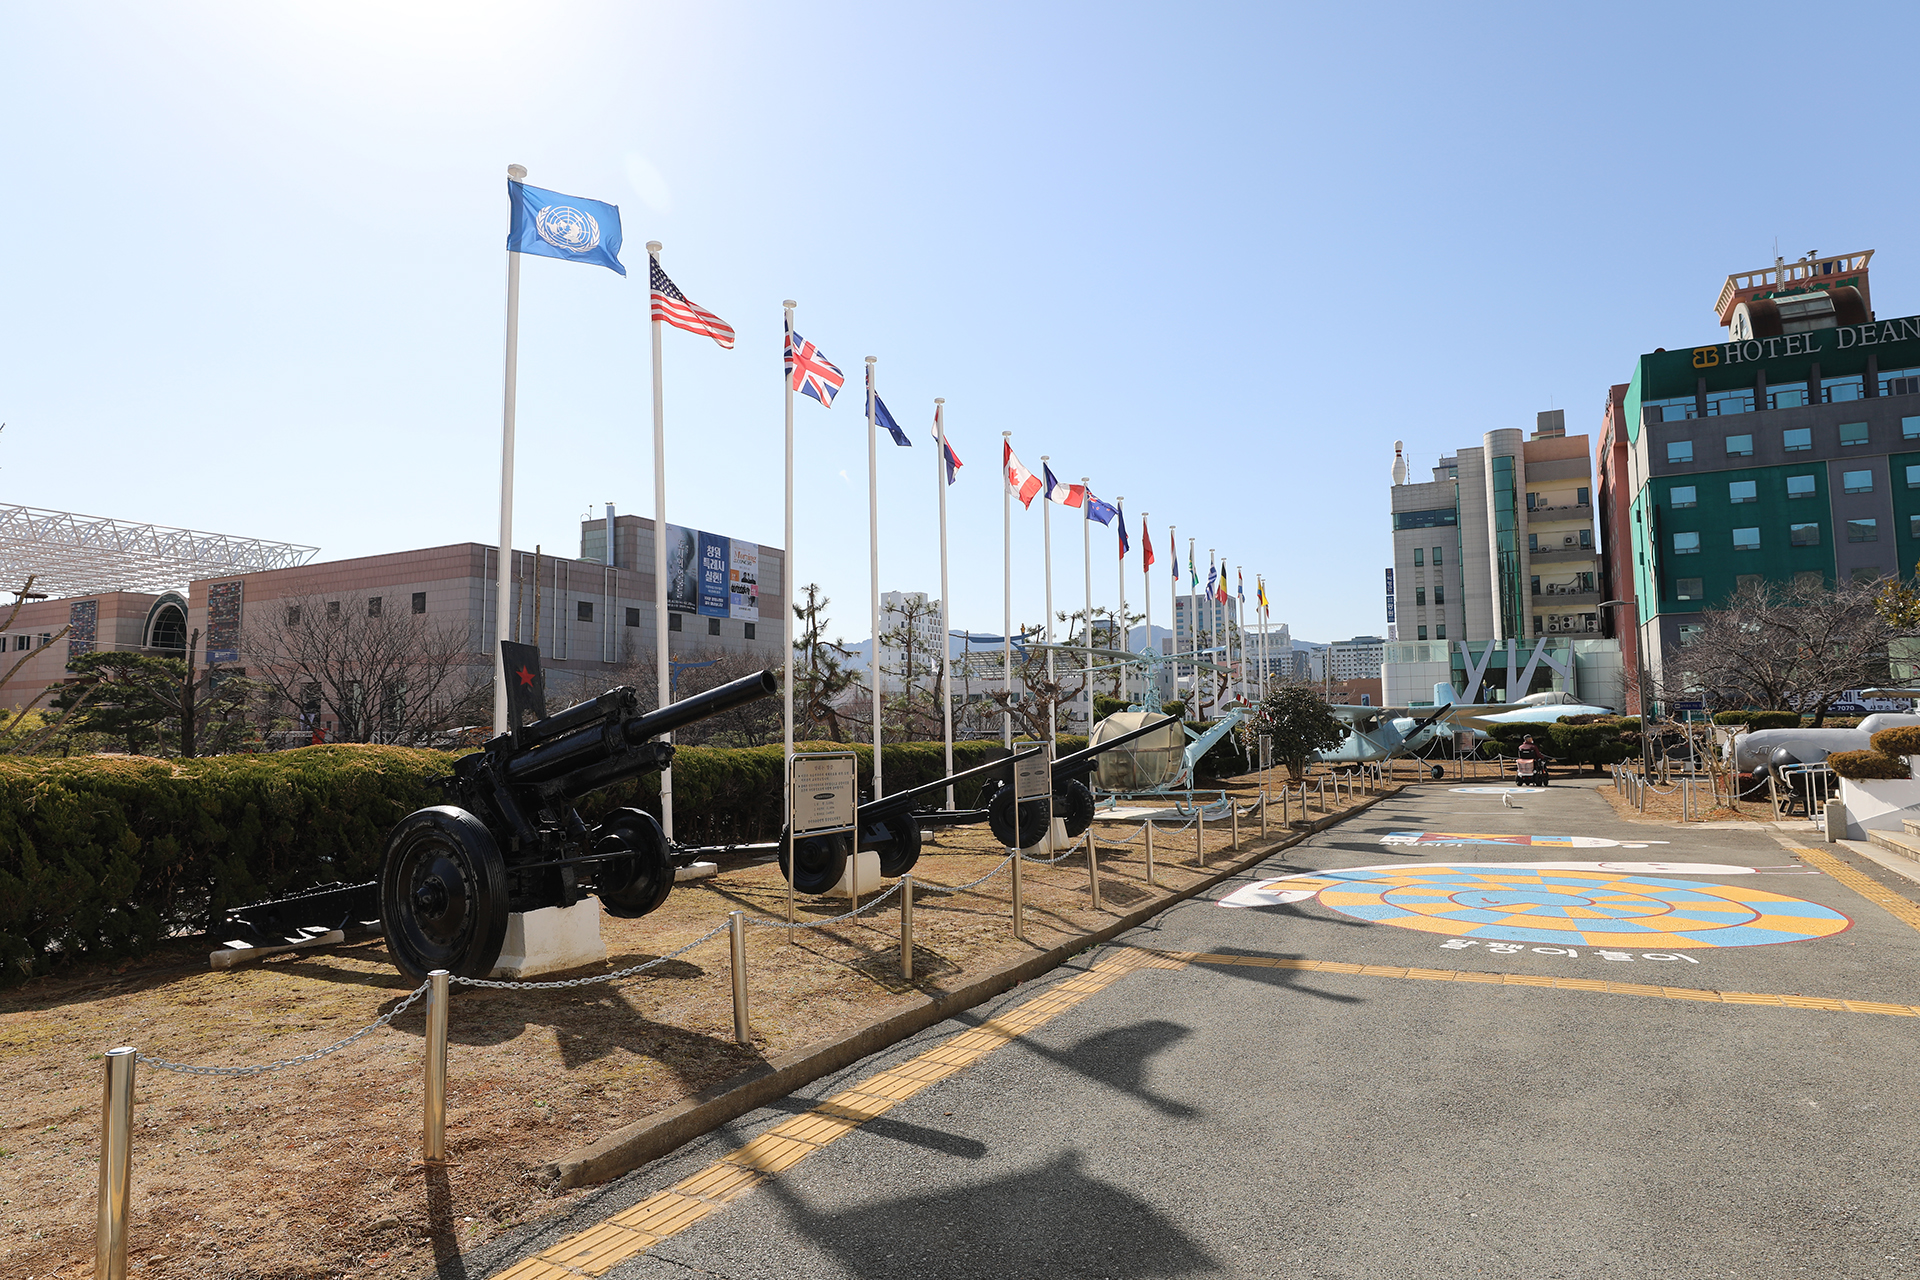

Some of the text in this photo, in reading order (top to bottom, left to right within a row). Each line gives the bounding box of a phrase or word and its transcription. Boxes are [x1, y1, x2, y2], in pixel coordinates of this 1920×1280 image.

[1724, 331, 1822, 365] HOTEL
[707, 545, 721, 558] 창원
[703, 557, 725, 571] 특례시
[705, 570, 722, 584] 실현!
[1439, 938, 1700, 964] 달팽이 놀이
